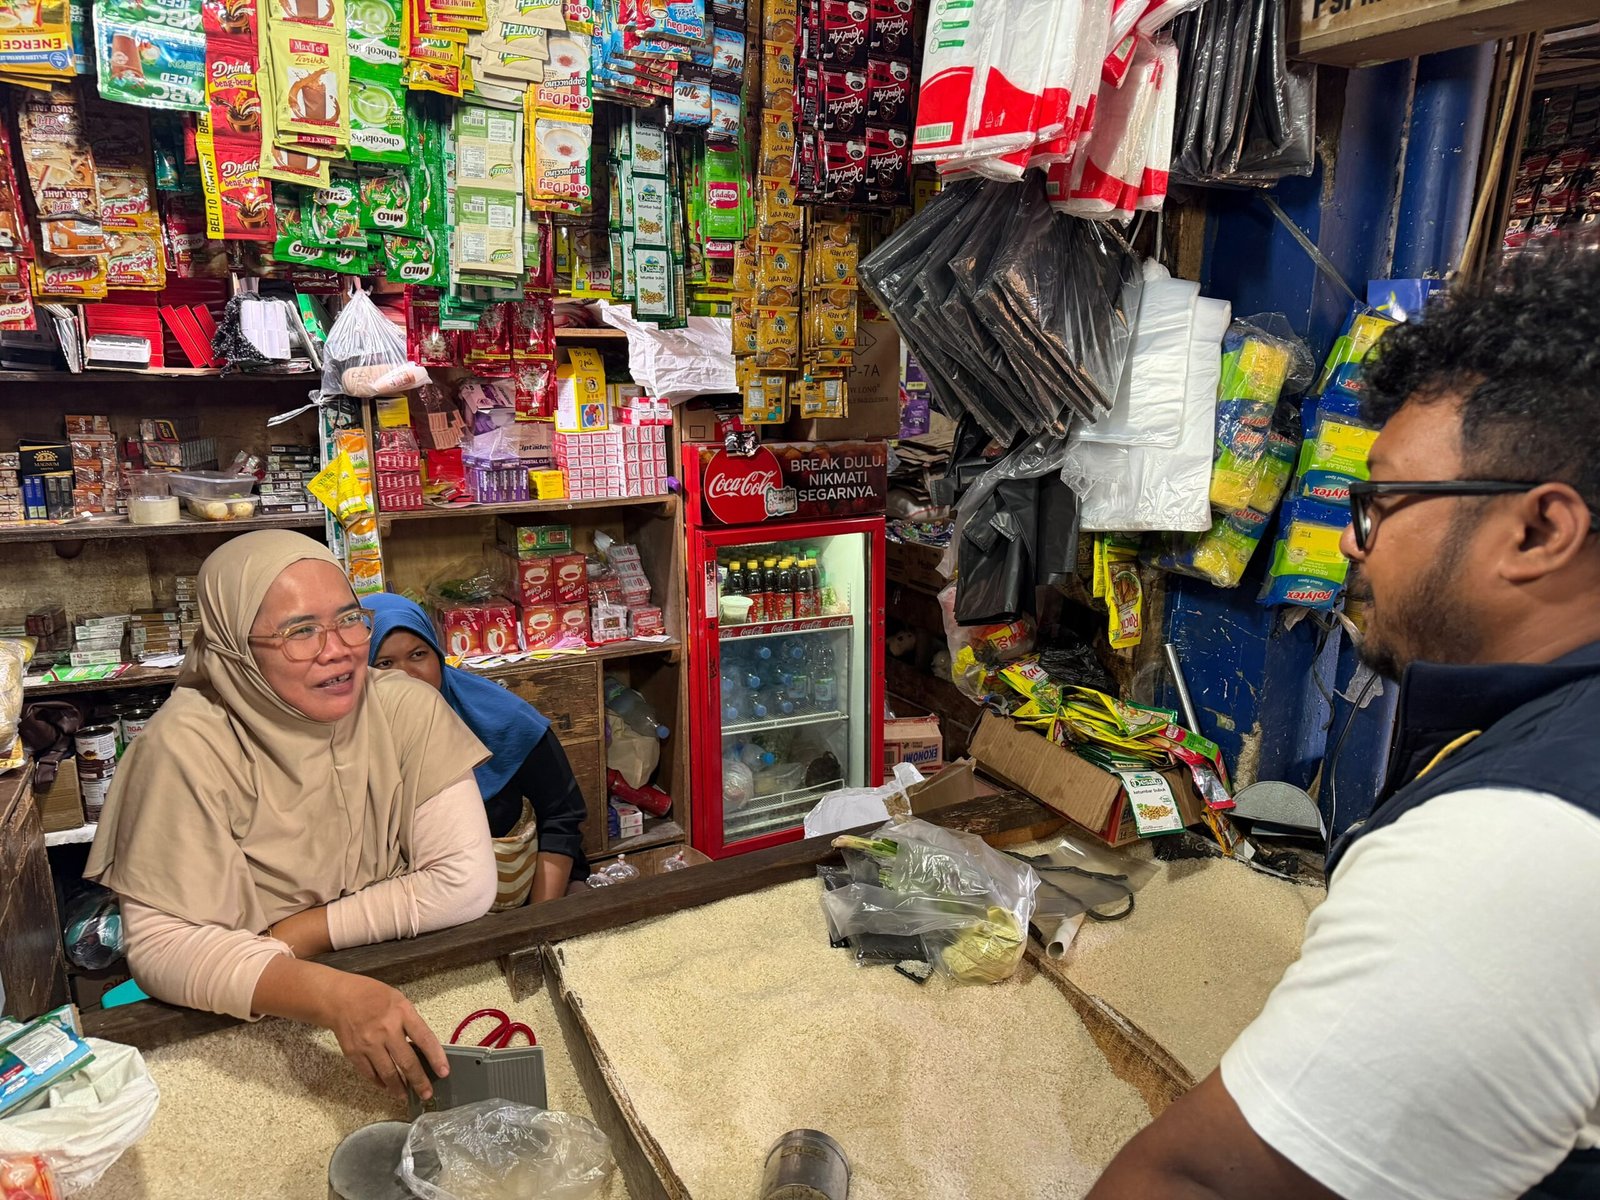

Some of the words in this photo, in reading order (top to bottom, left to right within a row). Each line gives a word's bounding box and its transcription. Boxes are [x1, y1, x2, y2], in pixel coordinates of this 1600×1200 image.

[563, 4, 591, 19] Good
[147, 10, 203, 32] ABC
[667, 19, 682, 33] Day
[683, 25, 702, 38] Good
[0, 38, 62, 50] ENERGE
[294, 40, 325, 54] MaxTea
[212, 61, 252, 77] Drink
[778, 64, 793, 72] TOP
[160, 72, 193, 86] ICED
[545, 77, 587, 89] Cappuccino
[148, 84, 204, 104] ABC
[538, 89, 562, 105] Day
[563, 95, 591, 109] Good
[50, 104, 74, 114] SUSU
[199, 113, 209, 134] BEL
[776, 131, 792, 139] TOP
[221, 161, 259, 177] Drink
[545, 166, 587, 178] Cappuccino
[539, 178, 562, 193] Day
[563, 183, 590, 196] Good
[43, 189, 65, 199] JAHE
[66, 189, 88, 199] SUSU
[773, 196, 790, 205] TOP
[207, 199, 217, 210] 10
[210, 212, 220, 232] BELI
[377, 211, 404, 223] MILO
[292, 244, 319, 257] MILO
[404, 265, 429, 275] MILO
[771, 261, 789, 270] TOP
[833, 263, 849, 272] TOP
[48, 265, 94, 285] Masako
[585, 269, 610, 284] acik
[0, 306, 29, 320] Royco
[771, 324, 788, 333] TOP
[832, 324, 848, 333] TOP
[790, 457, 840, 472] BREAK
[844, 455, 885, 470] DULU.
[1326, 462, 1356, 473] REGULAR
[809, 472, 867, 486] NIKMATI
[798, 485, 878, 502] SEGARNYA.
[1311, 487, 1350, 500] olytex
[1234, 509, 1265, 523] olytex
[1298, 566, 1329, 576] REGULAR
[1284, 589, 1334, 602] Polytex
[903, 748, 938, 763] EKONOMI
